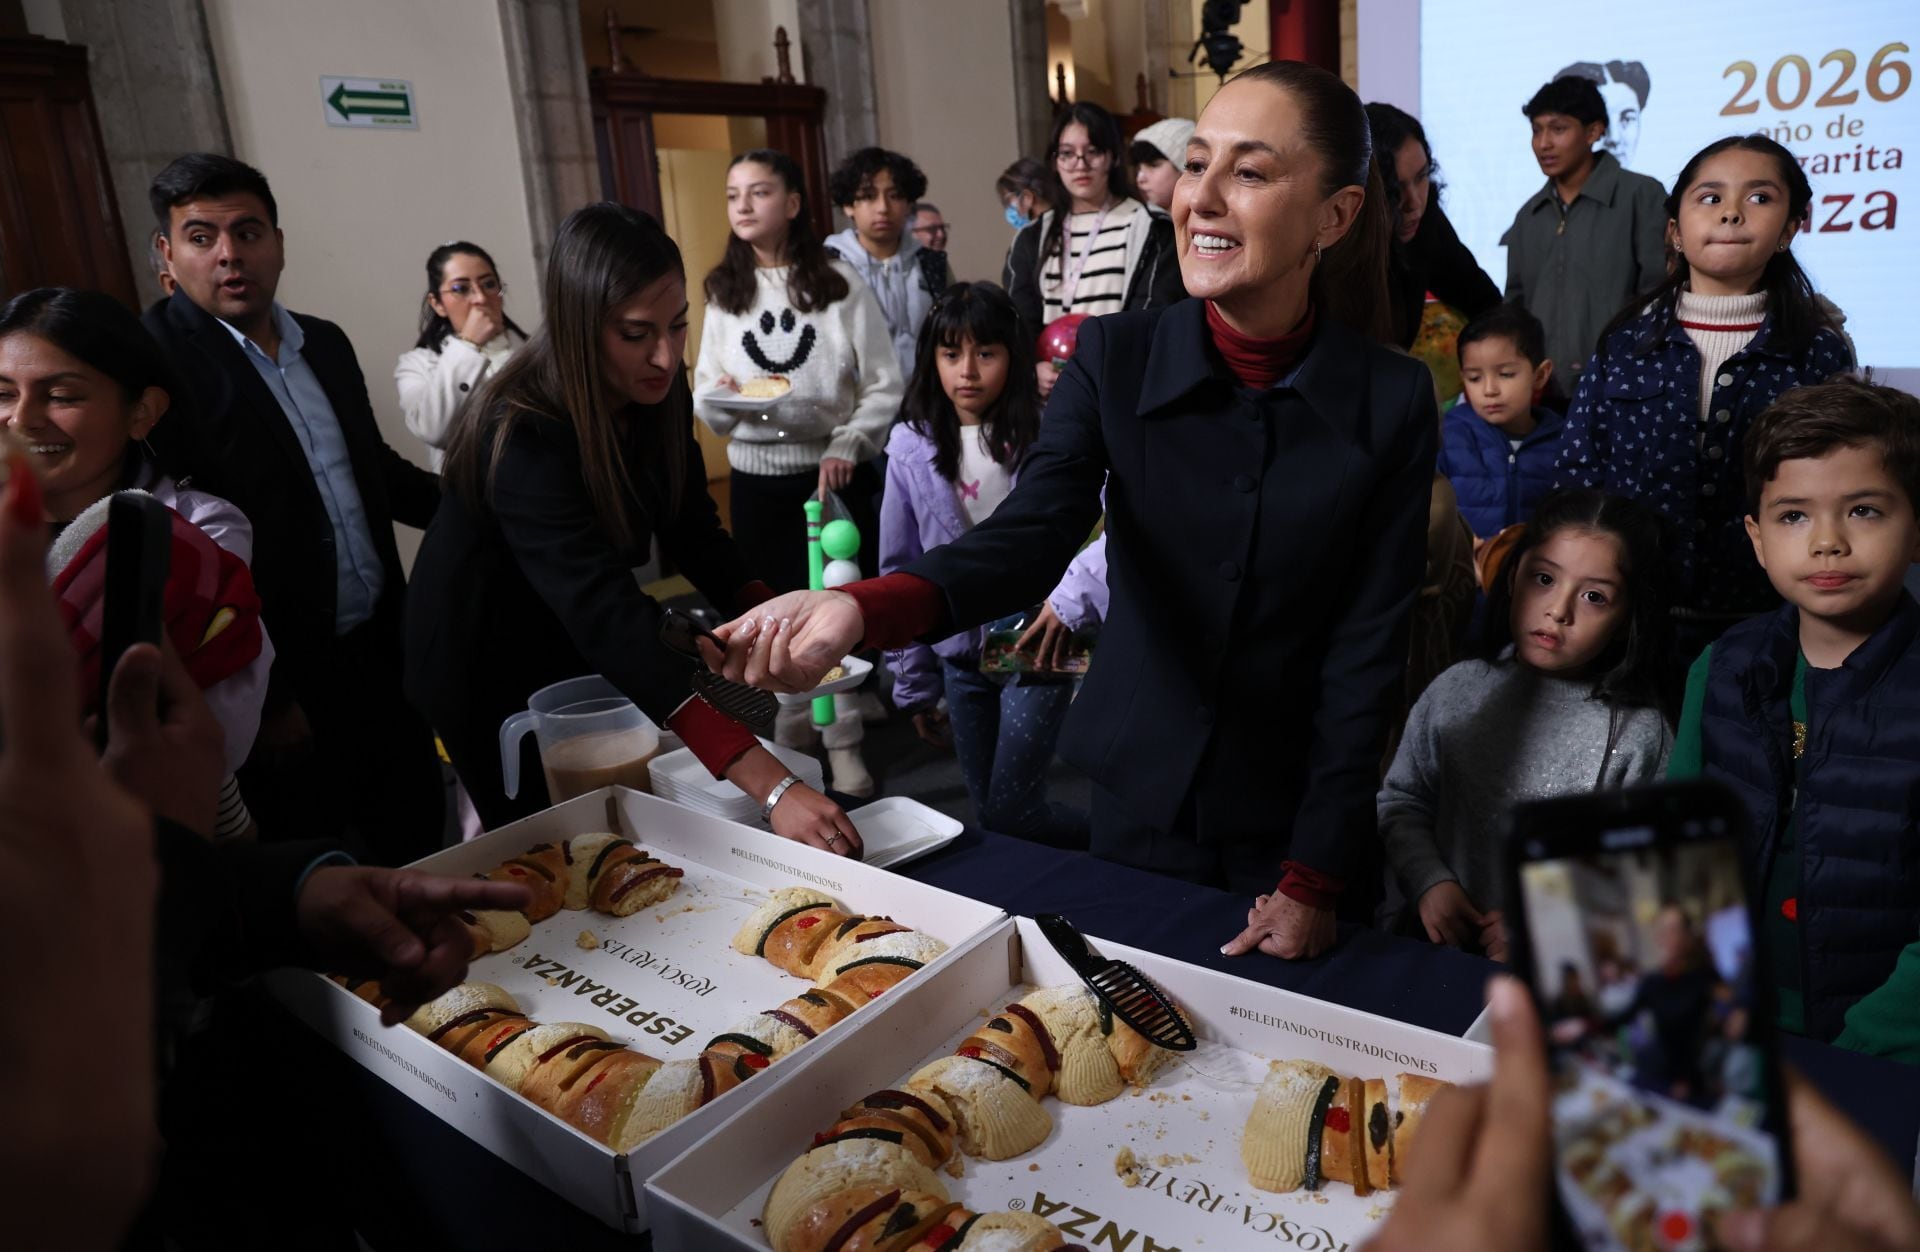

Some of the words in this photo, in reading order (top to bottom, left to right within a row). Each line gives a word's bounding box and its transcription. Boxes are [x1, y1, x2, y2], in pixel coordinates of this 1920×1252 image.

[1719, 42, 1912, 116] 2026
[1825, 113, 1864, 139] de
[1797, 144, 1903, 175] arita
[731, 847, 843, 892] #DELEITANDOTUSTRADICIONES
[601, 938, 657, 969] REYES
[657, 964, 719, 997] ROSCA
[1229, 1005, 1438, 1074] #DELEITANDOTUSTRADICIONES
[353, 1027, 457, 1103] #DELEITANDOTUSTRADICIONES
[1119, 1163, 1225, 1213] REYE
